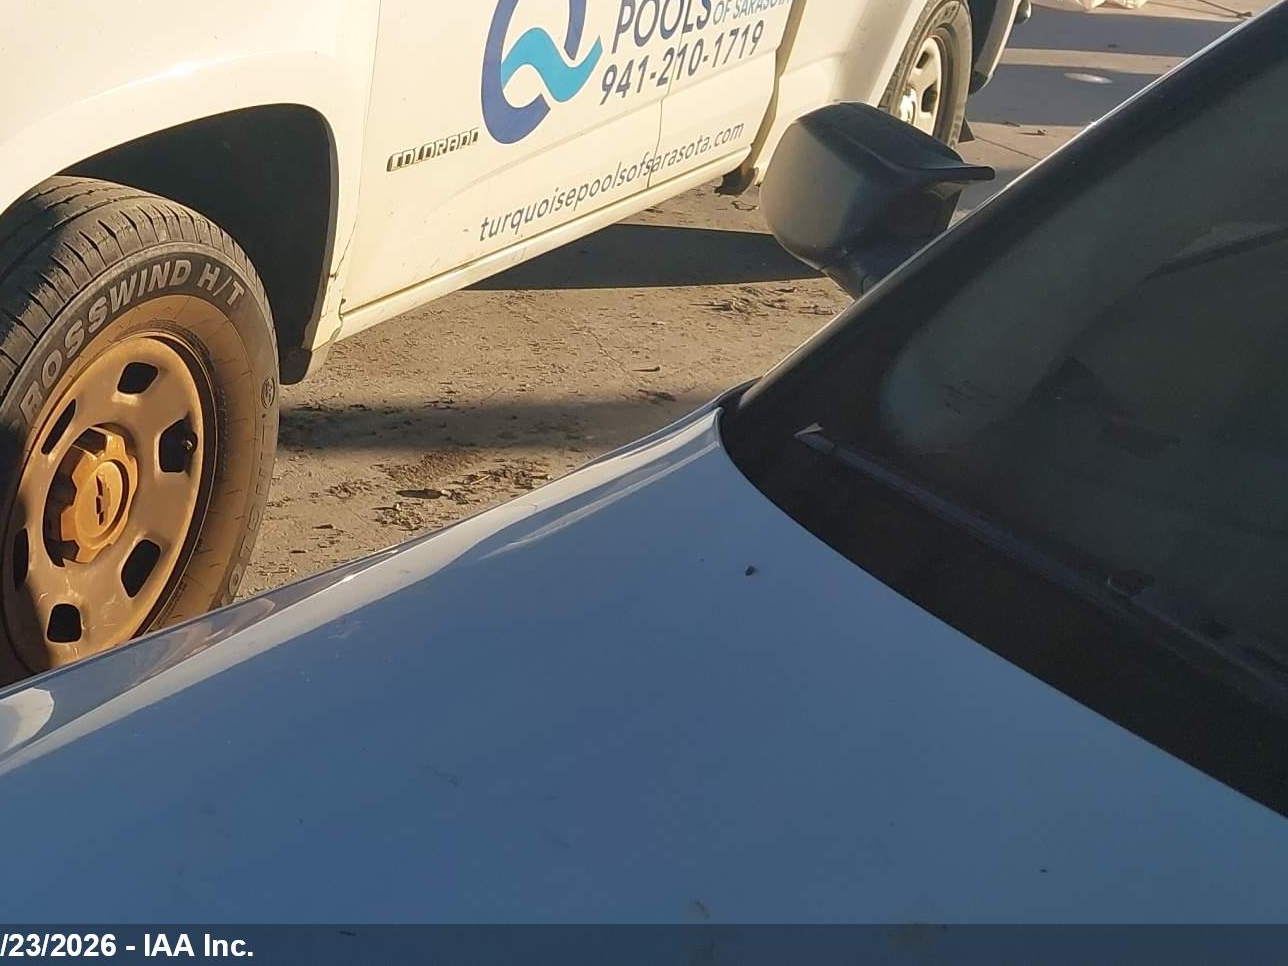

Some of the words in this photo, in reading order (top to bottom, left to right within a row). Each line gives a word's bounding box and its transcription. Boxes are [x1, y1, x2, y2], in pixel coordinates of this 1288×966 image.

[599, 19, 765, 105] 941-210-1719
[479, 122, 745, 242] turquoisepoolsofsarasota.com
[17, 258, 192, 424] ROSSWIND
[197, 262, 246, 307] H/T
